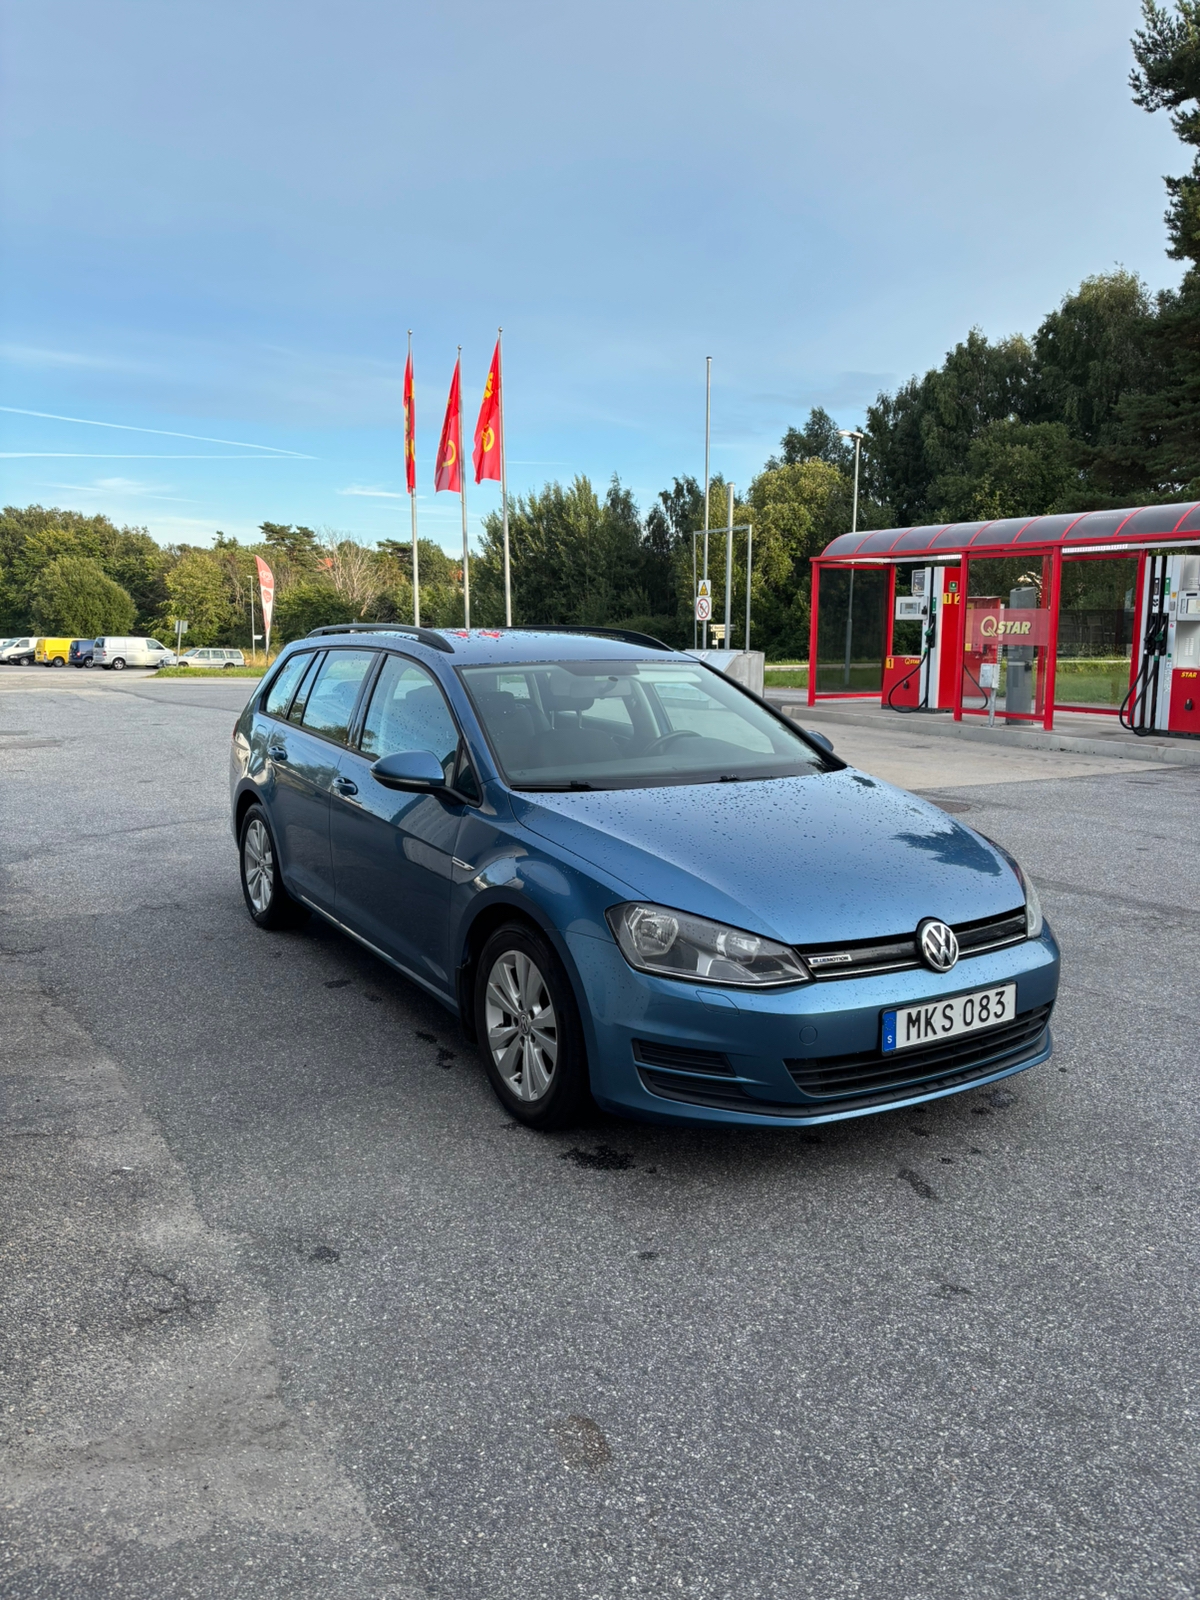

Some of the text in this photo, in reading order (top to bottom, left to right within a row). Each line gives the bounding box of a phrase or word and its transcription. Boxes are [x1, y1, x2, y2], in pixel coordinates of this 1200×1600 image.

[906, 990, 1006, 1041] MKS 083
[887, 1035, 893, 1044] S
